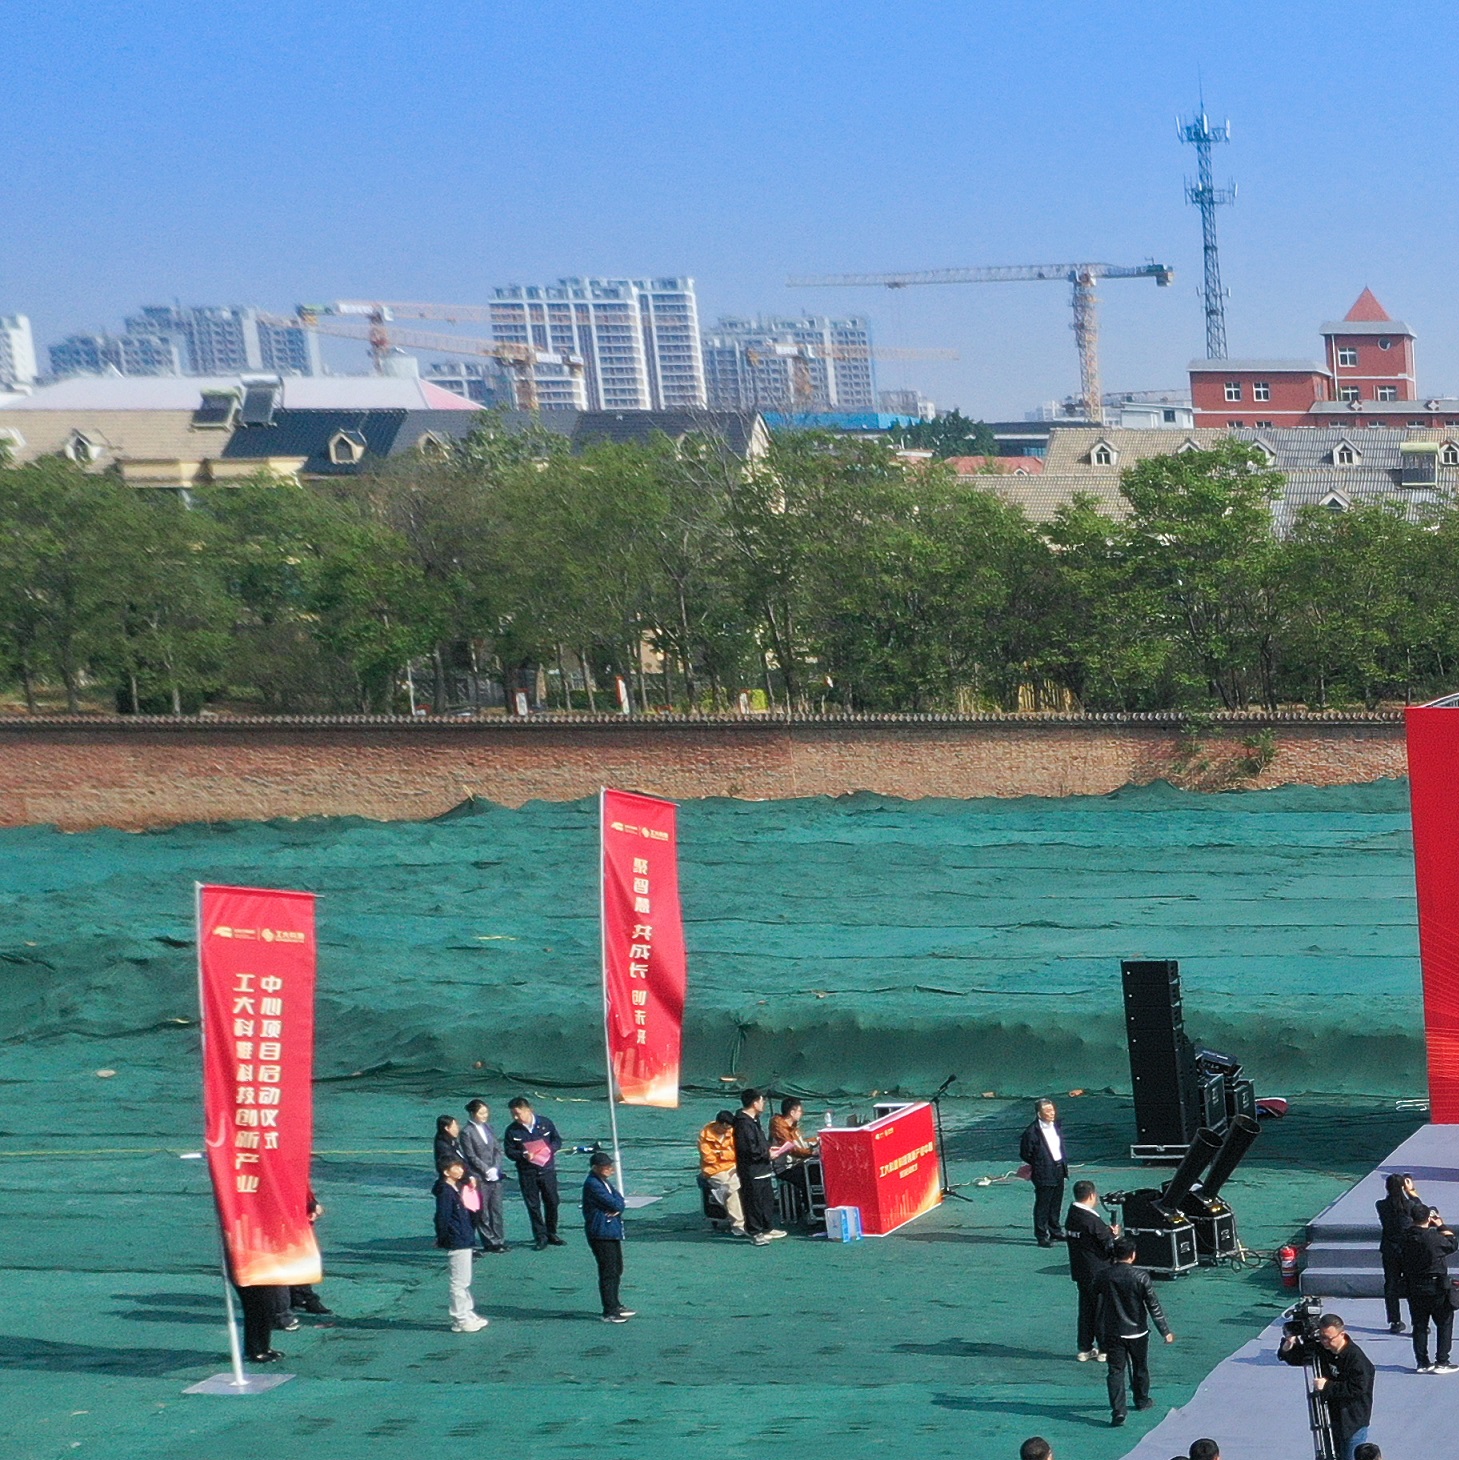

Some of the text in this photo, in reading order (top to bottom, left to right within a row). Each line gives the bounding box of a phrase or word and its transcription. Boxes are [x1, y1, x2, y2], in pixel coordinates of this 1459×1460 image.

[233, 974, 259, 1192] 工大科雅科技创新产业
[258, 976, 282, 1148] 中心项目启动仪式
